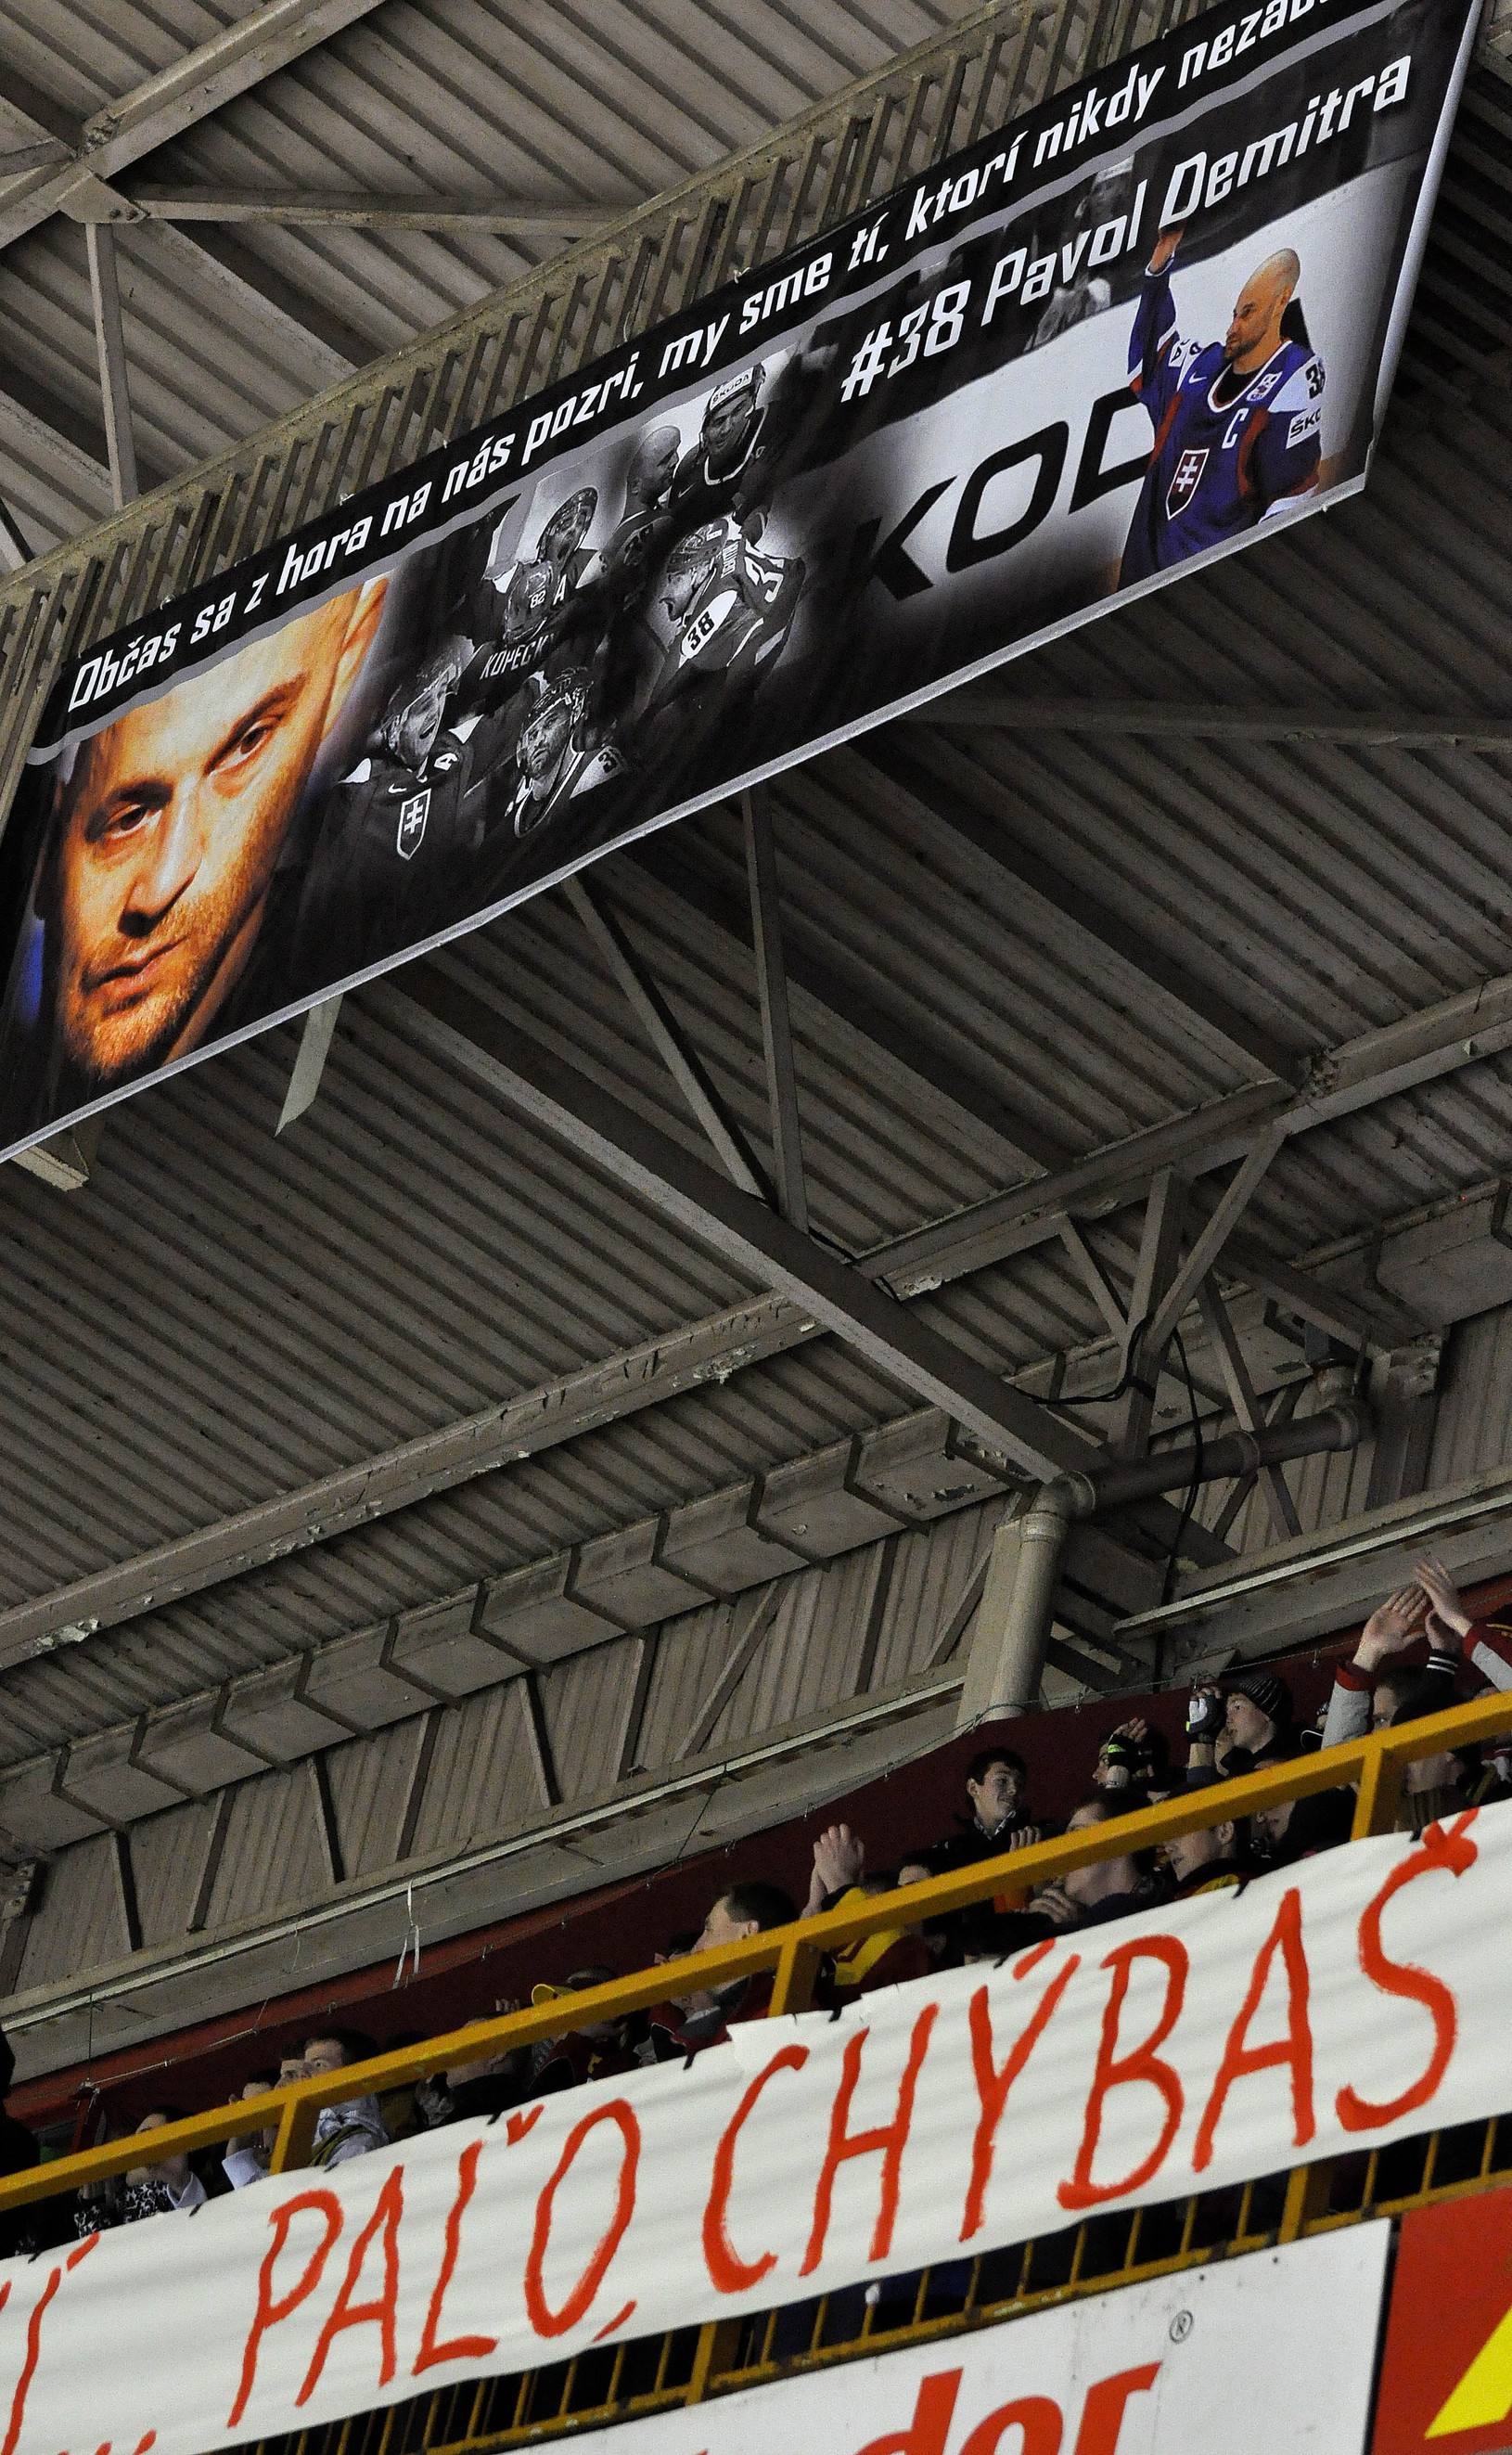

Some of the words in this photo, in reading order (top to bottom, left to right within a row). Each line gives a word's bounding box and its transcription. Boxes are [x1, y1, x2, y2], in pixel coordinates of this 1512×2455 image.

[68, 623, 182, 713] Občas
[190, 592, 237, 645] sa
[244, 573, 270, 613] z
[275, 543, 373, 596] hora
[380, 482, 433, 537] na
[442, 433, 517, 503] nás
[521, 351, 645, 467] pozri,
[658, 313, 731, 379] my
[739, 252, 833, 335] sme
[848, 212, 890, 272] tí,
[905, 131, 1029, 241] ktorí
[1032, 63, 1166, 169] nikdy
[840, 280, 972, 403] #38
[981, 179, 1147, 327] Pavol
[1160, 56, 1412, 229] Demitra
[1222, 407, 1249, 450] C
[686, 611, 715, 650] 38
[702, 1807, 1480, 2294] CHÝBAŠ
